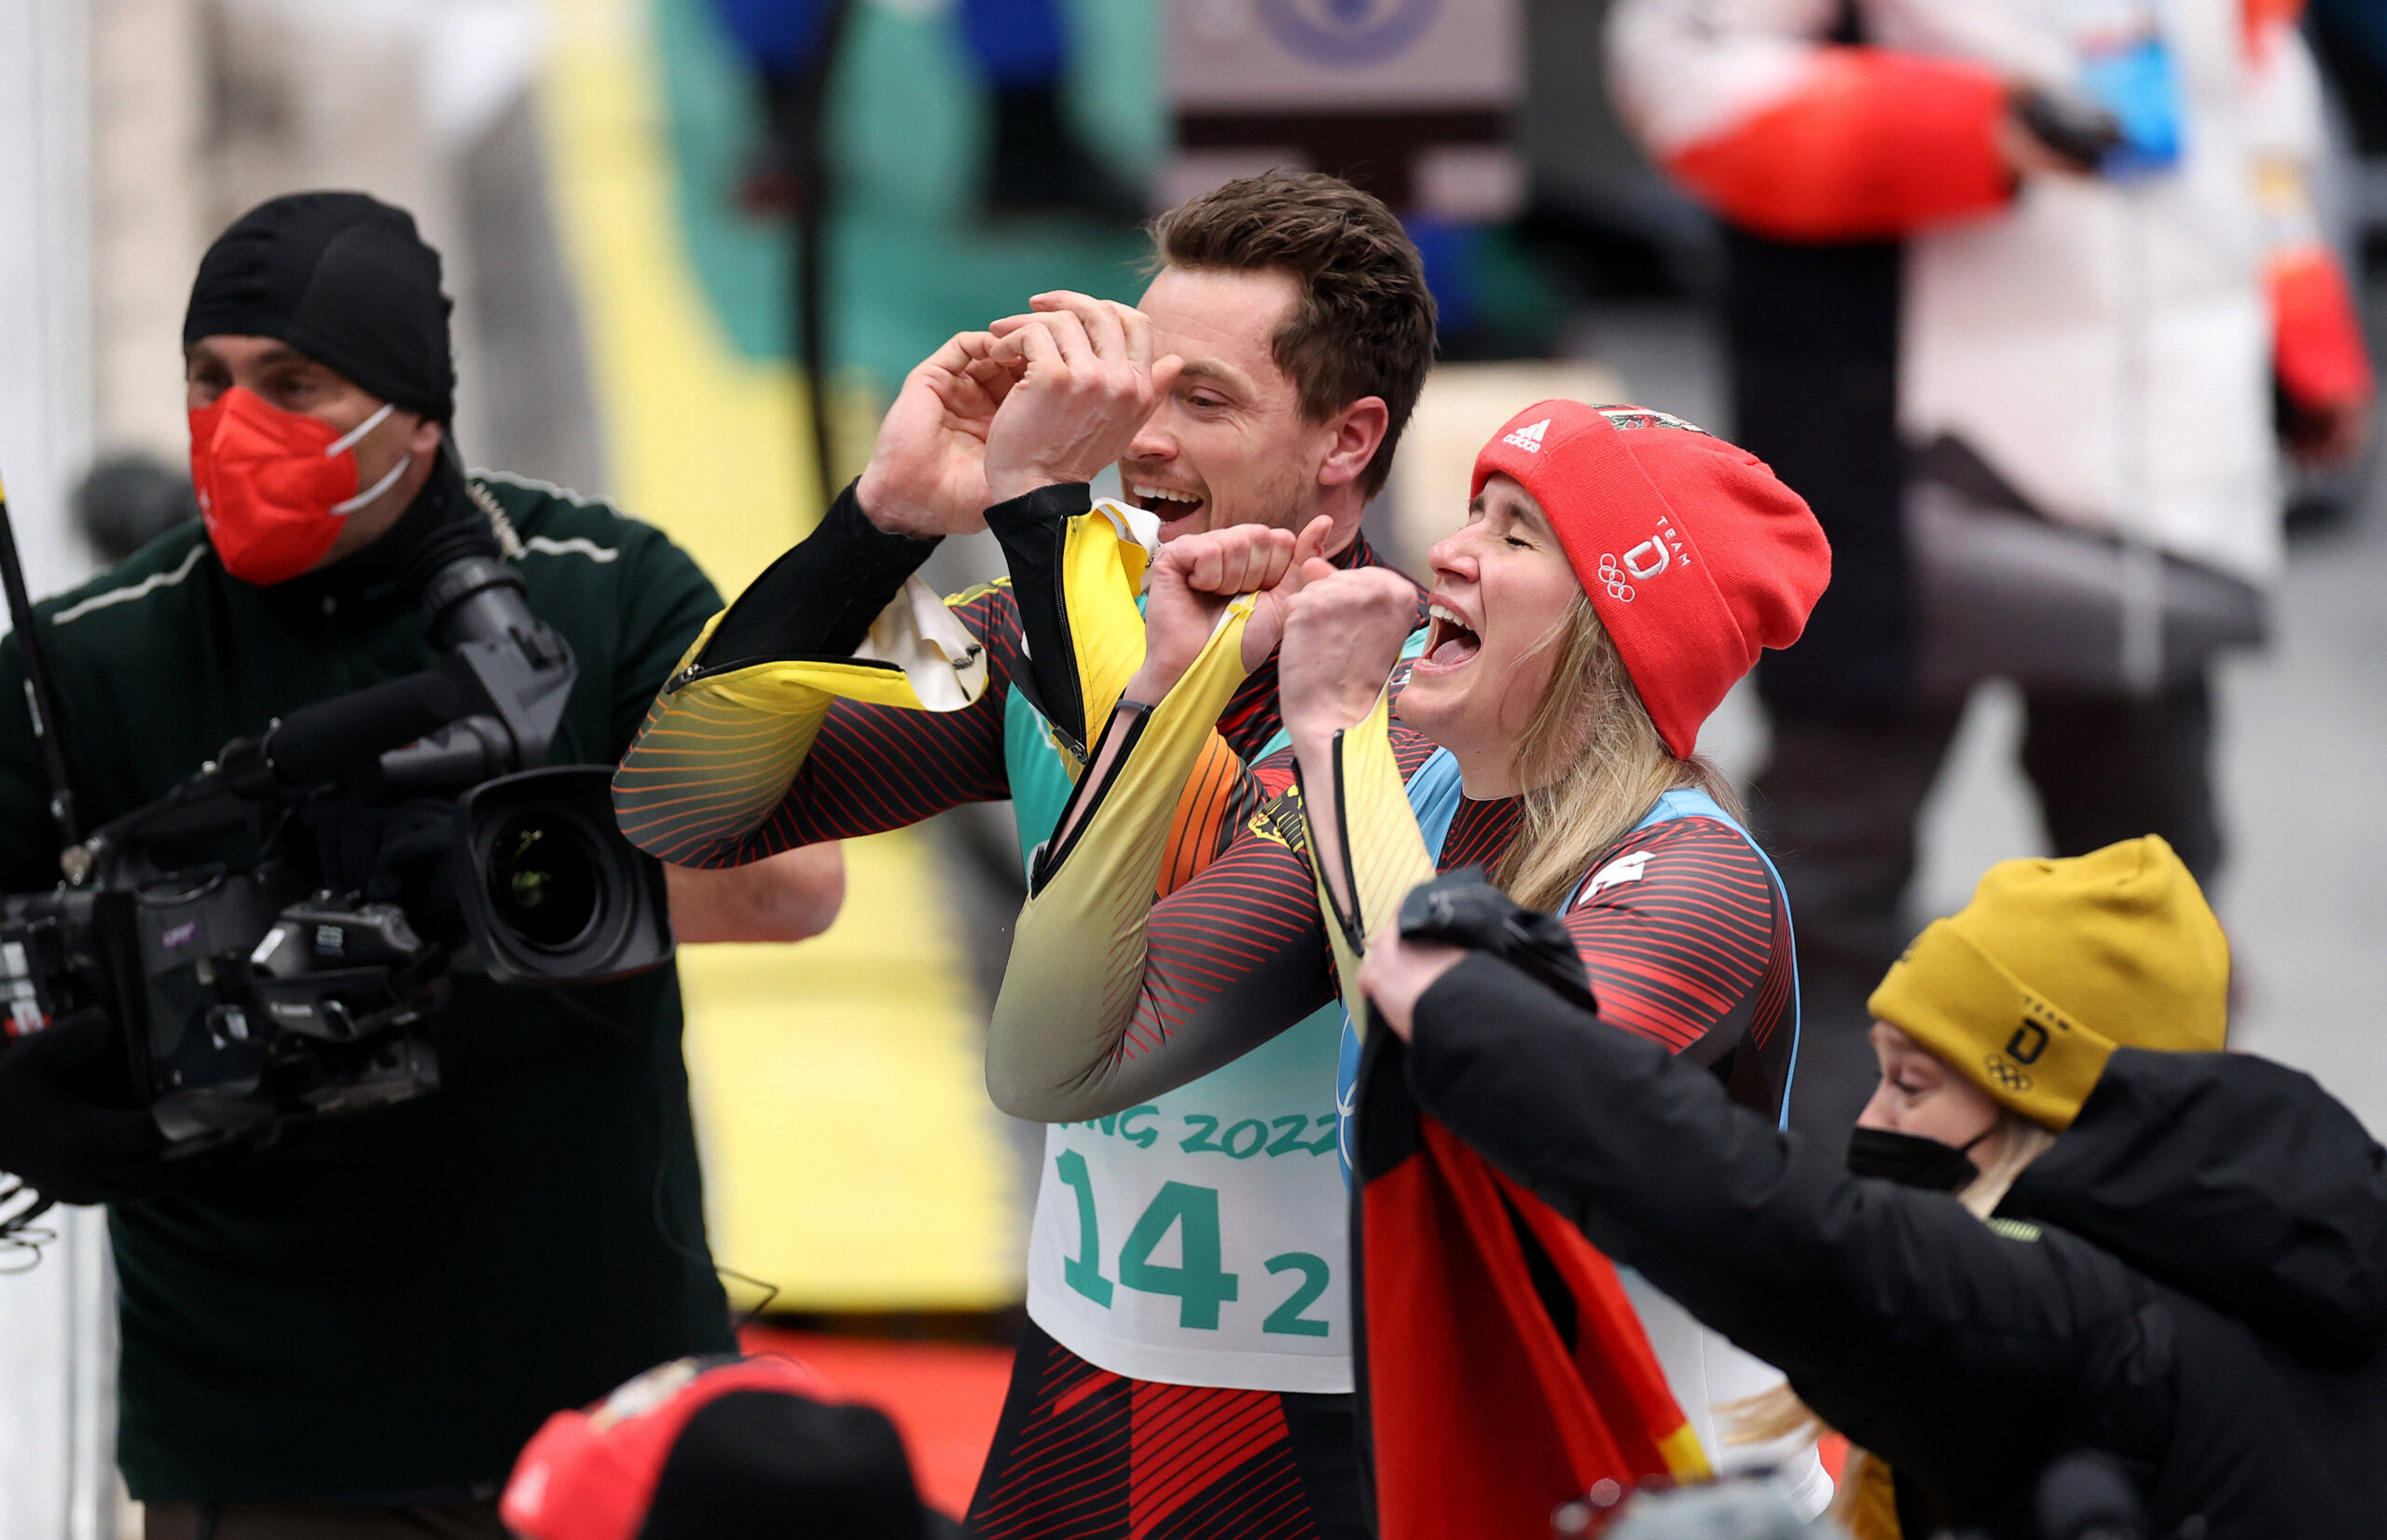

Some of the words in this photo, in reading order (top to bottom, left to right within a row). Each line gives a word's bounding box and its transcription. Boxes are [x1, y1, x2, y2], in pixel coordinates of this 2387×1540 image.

[1502, 433, 1541, 454] adidas
[1622, 534, 1671, 580] D
[1656, 515, 1692, 567] TEAM
[1055, 1148, 1239, 1331] 14
[1262, 1251, 1331, 1338] 2
